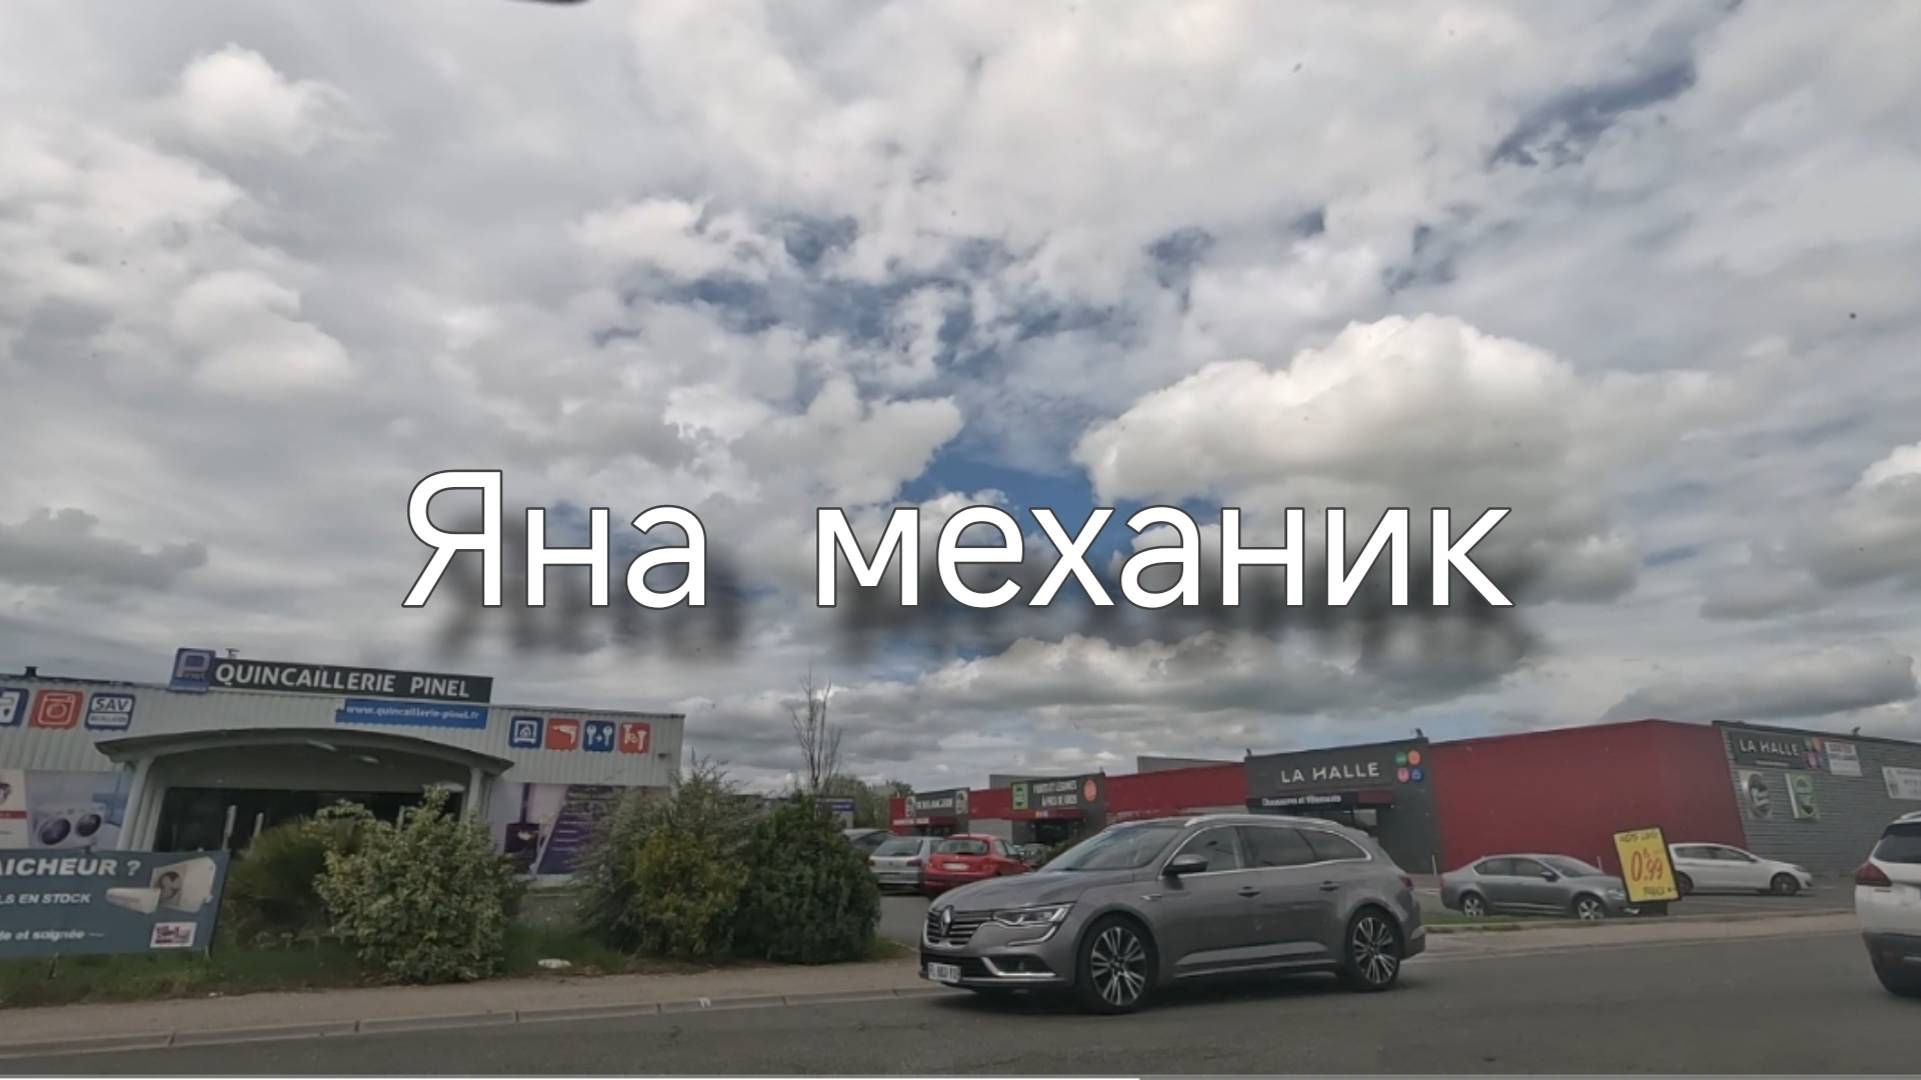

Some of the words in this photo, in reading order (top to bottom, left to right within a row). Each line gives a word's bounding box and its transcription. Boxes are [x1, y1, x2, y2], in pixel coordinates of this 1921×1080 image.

[215, 663, 396, 693] QUINCAILLERIE
[410, 676, 470, 698] PINEL
[95, 698, 130, 711] SAV
[1739, 739, 1756, 753] LA
[1760, 741, 1799, 756] HALLE
[1281, 769, 1305, 783] LA
[1312, 762, 1380, 781] HALLE
[0, 858, 116, 876] ICHEUR
[18, 893, 40, 905] EN
[41, 893, 92, 905] STOCK
